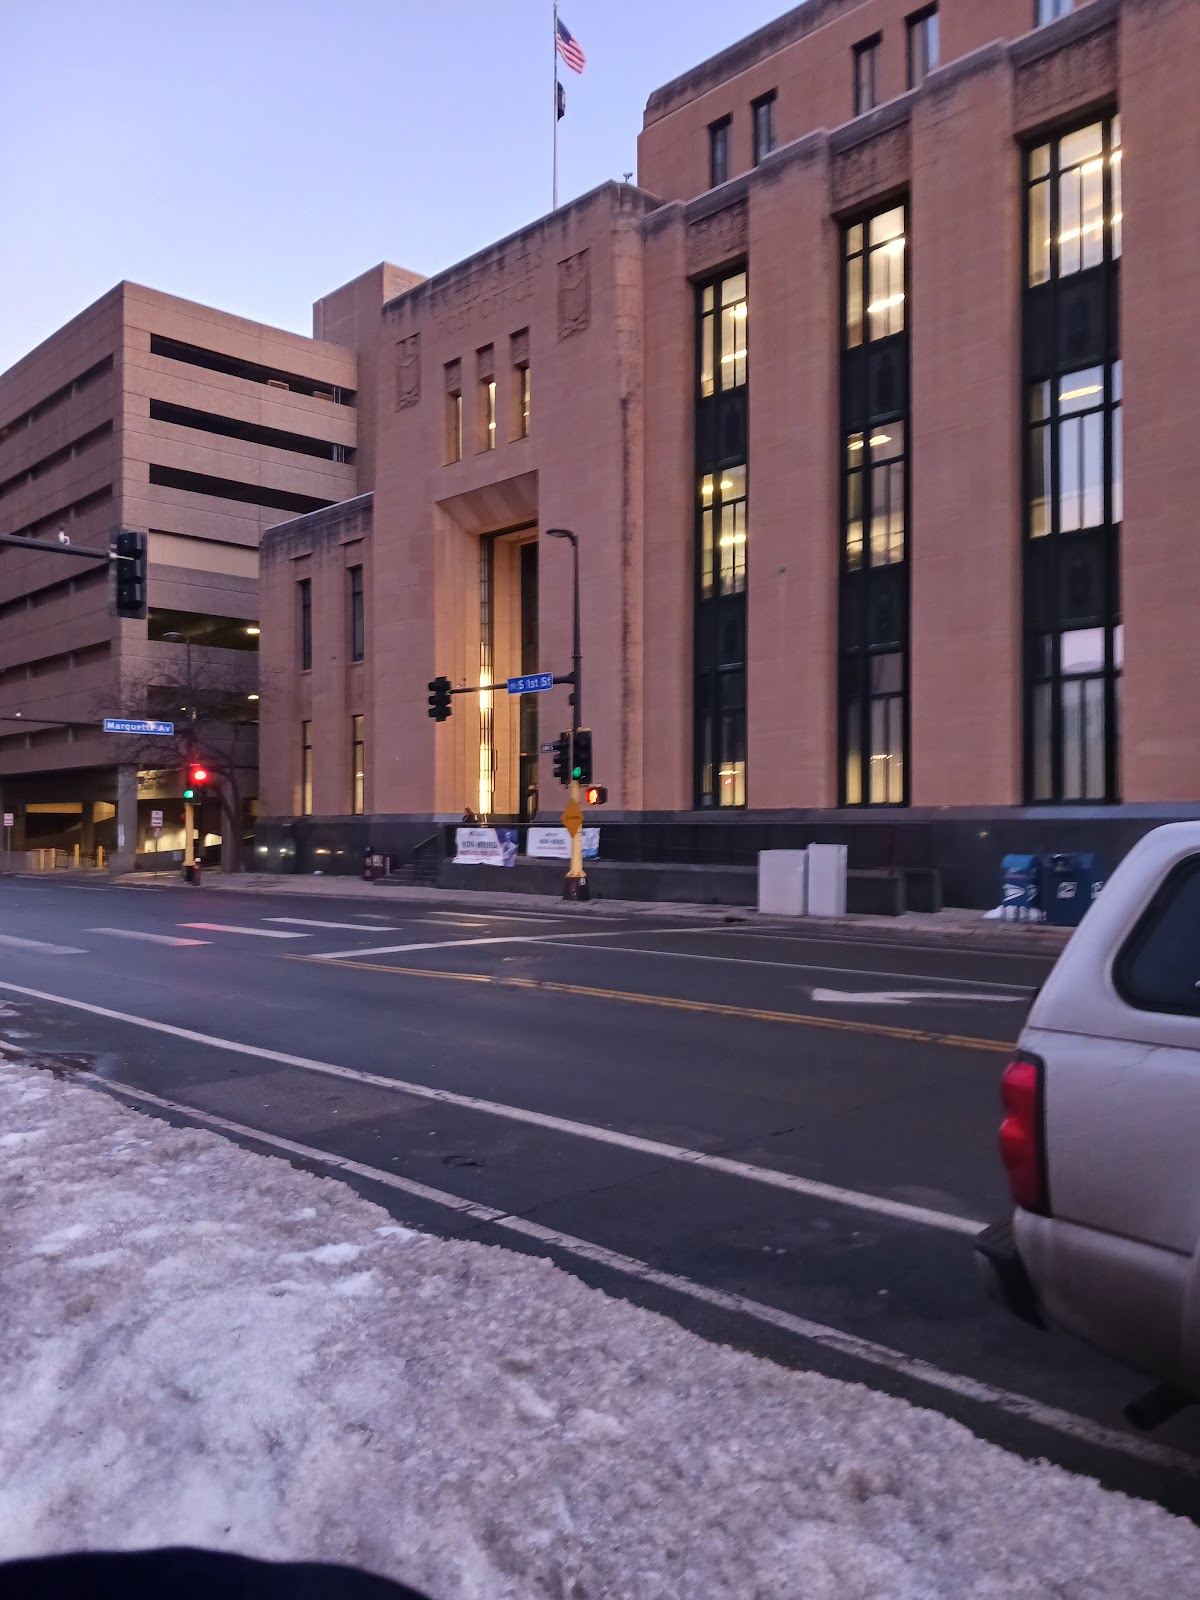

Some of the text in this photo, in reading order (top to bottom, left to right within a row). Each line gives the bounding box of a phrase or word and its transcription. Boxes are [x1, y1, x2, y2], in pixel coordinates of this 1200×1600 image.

[527, 678, 539, 689] 1st
[541, 676, 551, 687] St
[107, 721, 171, 732] Marquette Av
